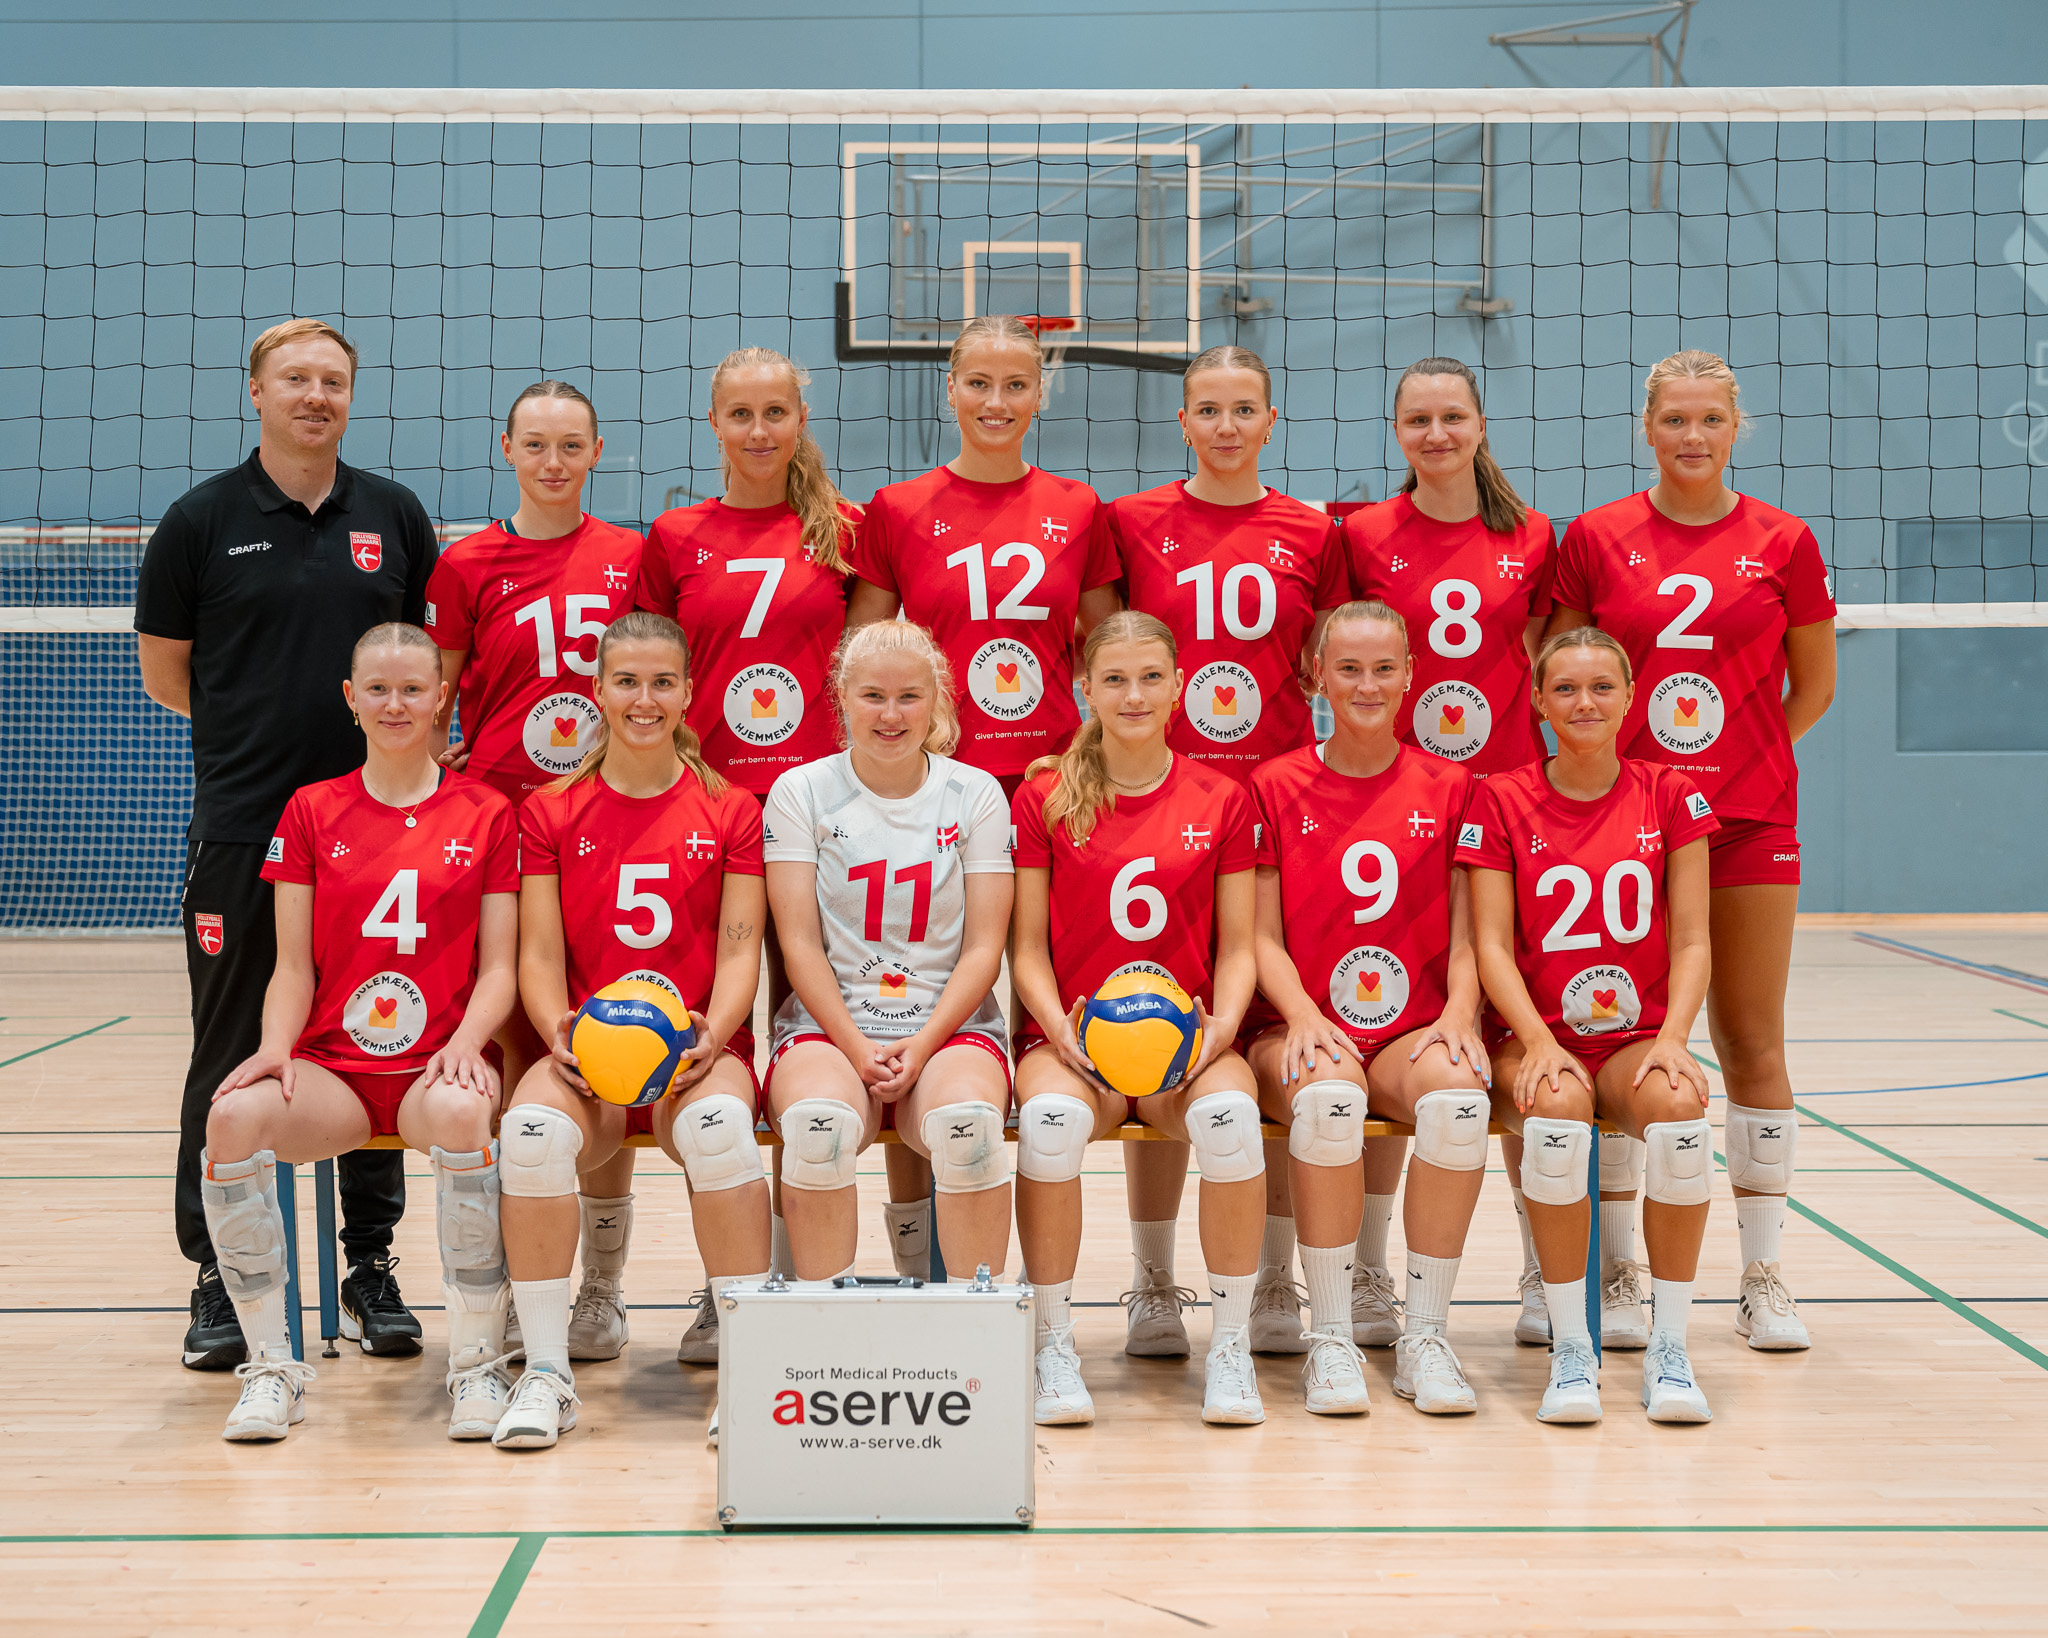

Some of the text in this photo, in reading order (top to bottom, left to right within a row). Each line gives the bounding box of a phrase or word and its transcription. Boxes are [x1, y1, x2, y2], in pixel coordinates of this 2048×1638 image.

[228, 543, 262, 556] CRAFT
[352, 538, 380, 546] DANMARK
[1044, 533, 1067, 545] DEN
[1269, 556, 1293, 569] DEN
[946, 542, 1050, 620] 12
[1499, 571, 1523, 581] DEN
[1736, 570, 1762, 579] DEN
[607, 582, 627, 591] DEN
[726, 557, 786, 639] 7
[1176, 560, 1277, 641] 10
[1428, 578, 1483, 659] 8
[1656, 573, 1714, 651] 2
[515, 594, 610, 678] 15
[974, 641, 1036, 670] JULEMÆRKE
[730, 667, 797, 696] JULEMÆRKE
[1193, 664, 1256, 692] JULEMÆRKE
[1421, 684, 1486, 711] JULEMÆRKE
[1655, 676, 1719, 704] JULEMÆRKE
[532, 696, 598, 723] JULEMÆRKE
[981, 695, 1037, 717] HJEMMENE
[735, 720, 794, 742] HJEMMENE
[974, 733, 994, 741] Giver
[995, 731, 1012, 739] børn
[1196, 717, 1253, 739] HJEMMENE
[1423, 736, 1481, 758] HJEMMENE
[1657, 729, 1714, 751] HJEMMENE
[728, 758, 746, 766] Giver
[748, 756, 765, 764] børn
[778, 756, 787, 765] ny
[788, 755, 803, 763] start
[1188, 752, 1207, 760] Giver
[1234, 753, 1243, 761] ny
[1705, 765, 1721, 773] start
[1410, 830, 1434, 838] DEN
[687, 852, 714, 860] DEN
[1184, 842, 1210, 851] DEN
[1773, 853, 1796, 862] CRAFT
[444, 857, 471, 867] DEN
[1341, 840, 1399, 925] 9
[614, 863, 673, 950] 5
[847, 858, 932, 943] 11
[1109, 856, 1168, 942] 6
[1536, 859, 1654, 953] 20
[361, 868, 427, 955] 4
[1338, 949, 1403, 977] JULEMÆRKE
[1568, 968, 1633, 997] JULEMÆRKE
[860, 999, 923, 1020] HJEMMENE
[1340, 1004, 1399, 1026] HJEMMENE
[351, 1028, 413, 1053] HJEMMENE
[785, 1367, 958, 1382] Sport Medical Products
[799, 1435, 943, 1450] www.a-serve.dk
